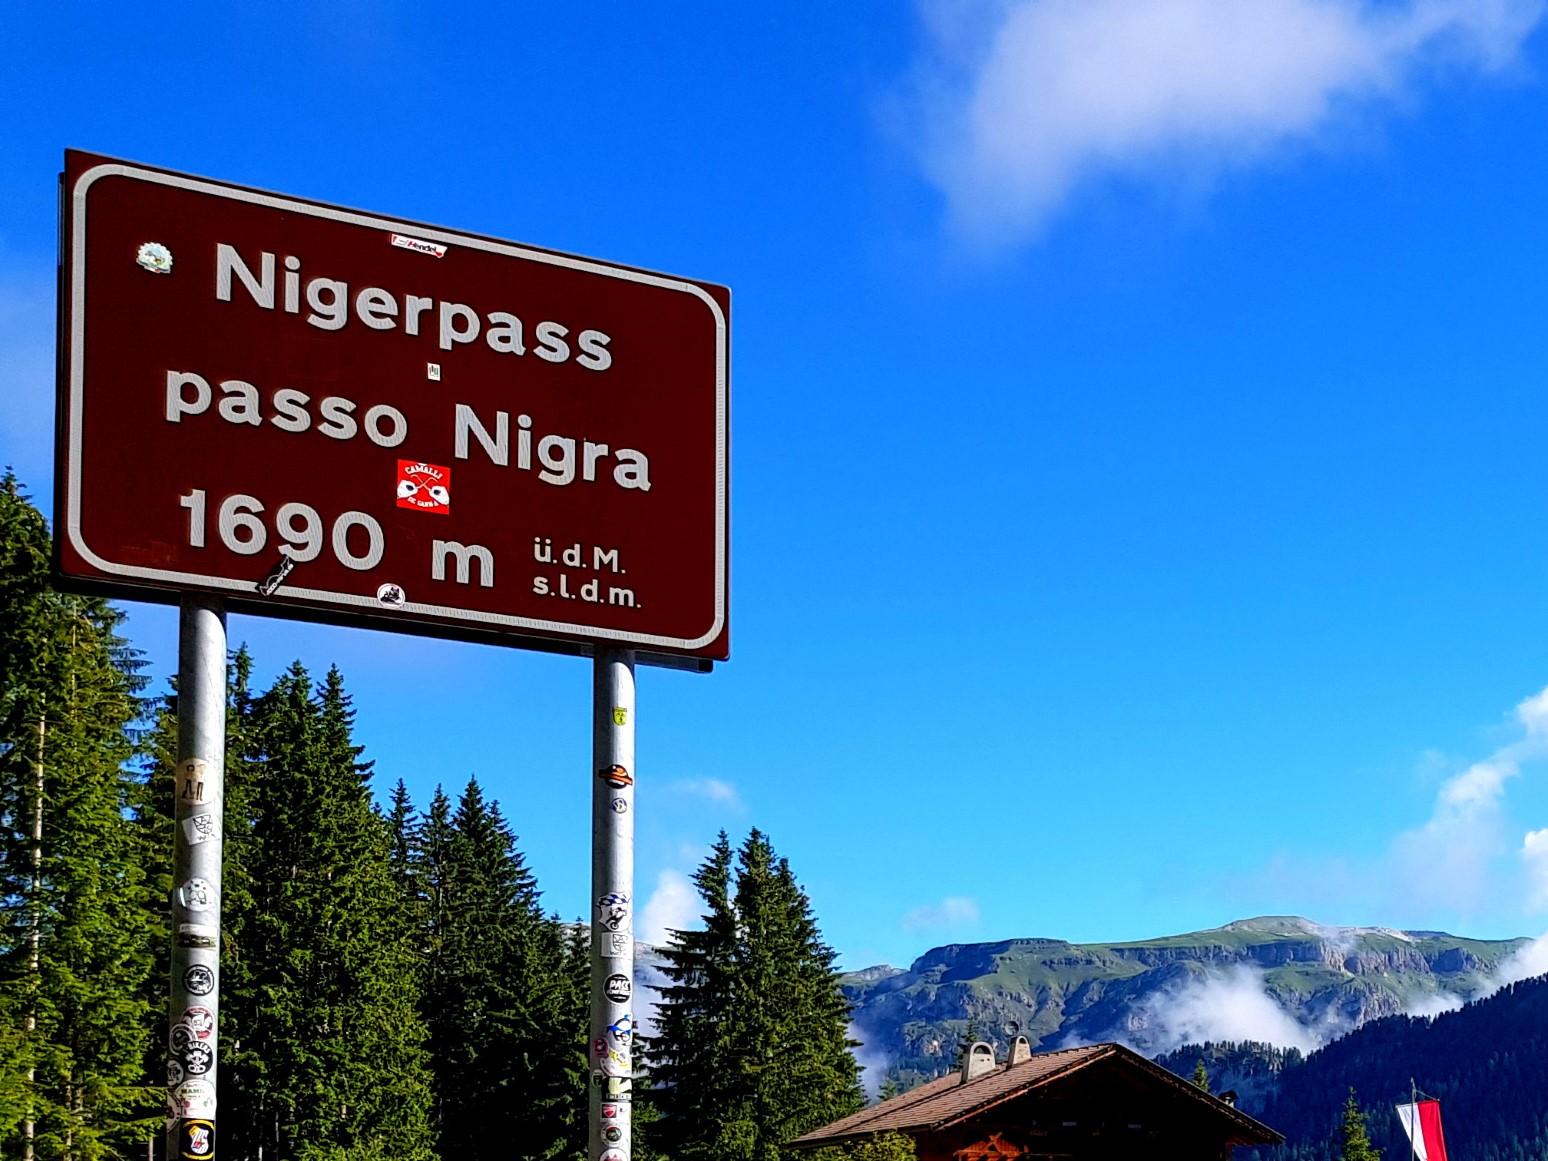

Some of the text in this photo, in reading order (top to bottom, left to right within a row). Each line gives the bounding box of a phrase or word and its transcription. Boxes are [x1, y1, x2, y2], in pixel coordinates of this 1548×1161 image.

[215, 242, 613, 371] Nigerpass
[165, 368, 652, 492] passo Nigra
[179, 488, 494, 588] 1690 m
